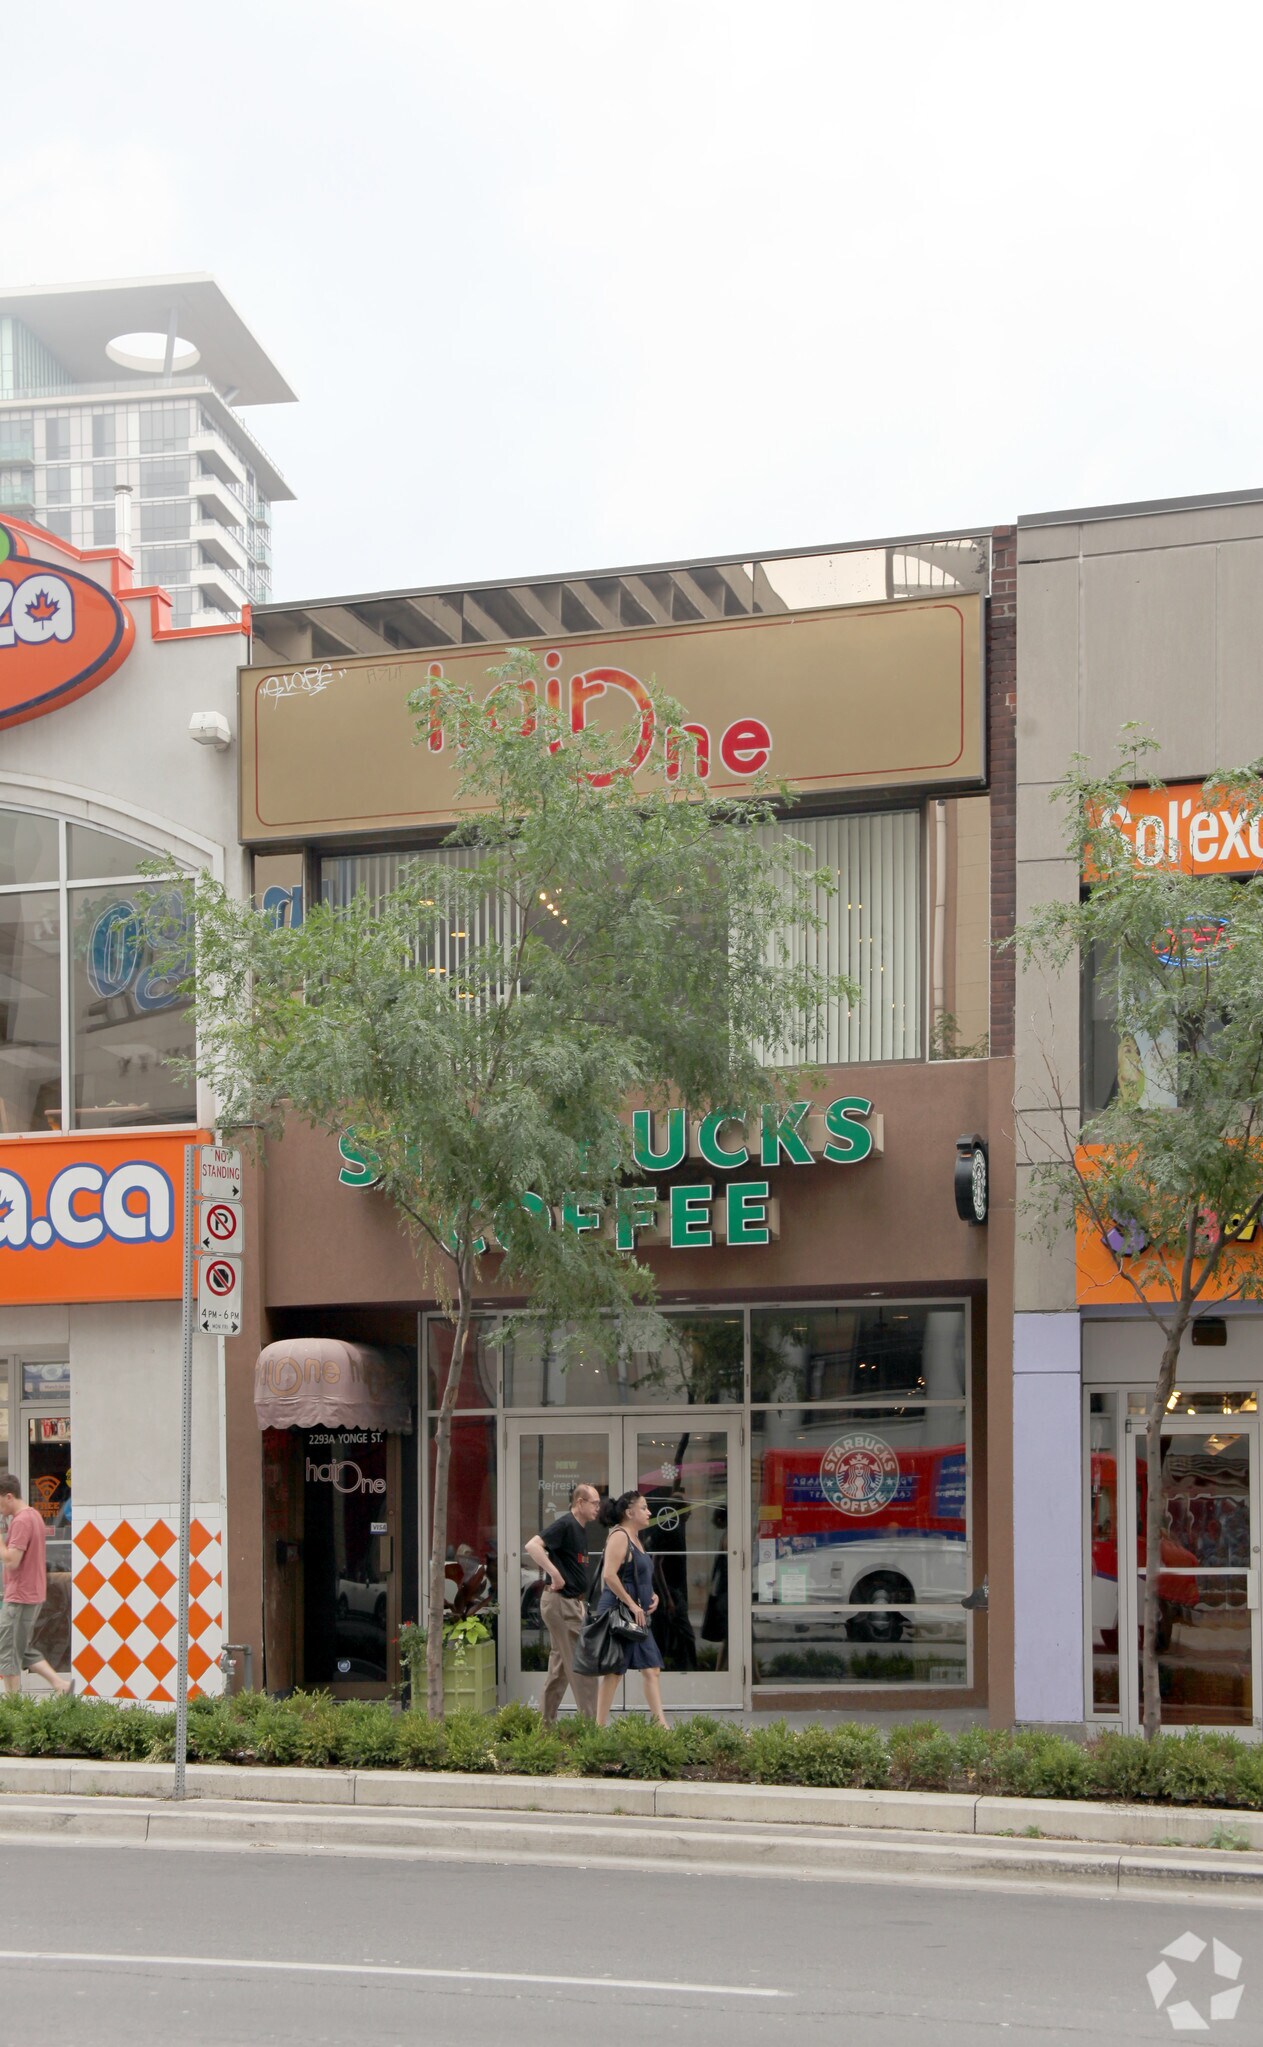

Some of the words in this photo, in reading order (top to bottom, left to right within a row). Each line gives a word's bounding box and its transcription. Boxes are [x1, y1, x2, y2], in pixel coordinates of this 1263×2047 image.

[215, 1149, 227, 1163] NO
[202, 1163, 240, 1180] STANDING
[201, 1308, 207, 1318] 4
[208, 1310, 217, 1319] PM
[223, 1309, 229, 1320] 6
[230, 1311, 240, 1320] PM
[309, 1434, 336, 1445] 2293A
[338, 1433, 368, 1444] YONGE
[371, 1432, 383, 1443] ST.
[824, 1436, 896, 1472] STARBUCKS
[832, 1491, 888, 1513] COFFEE
